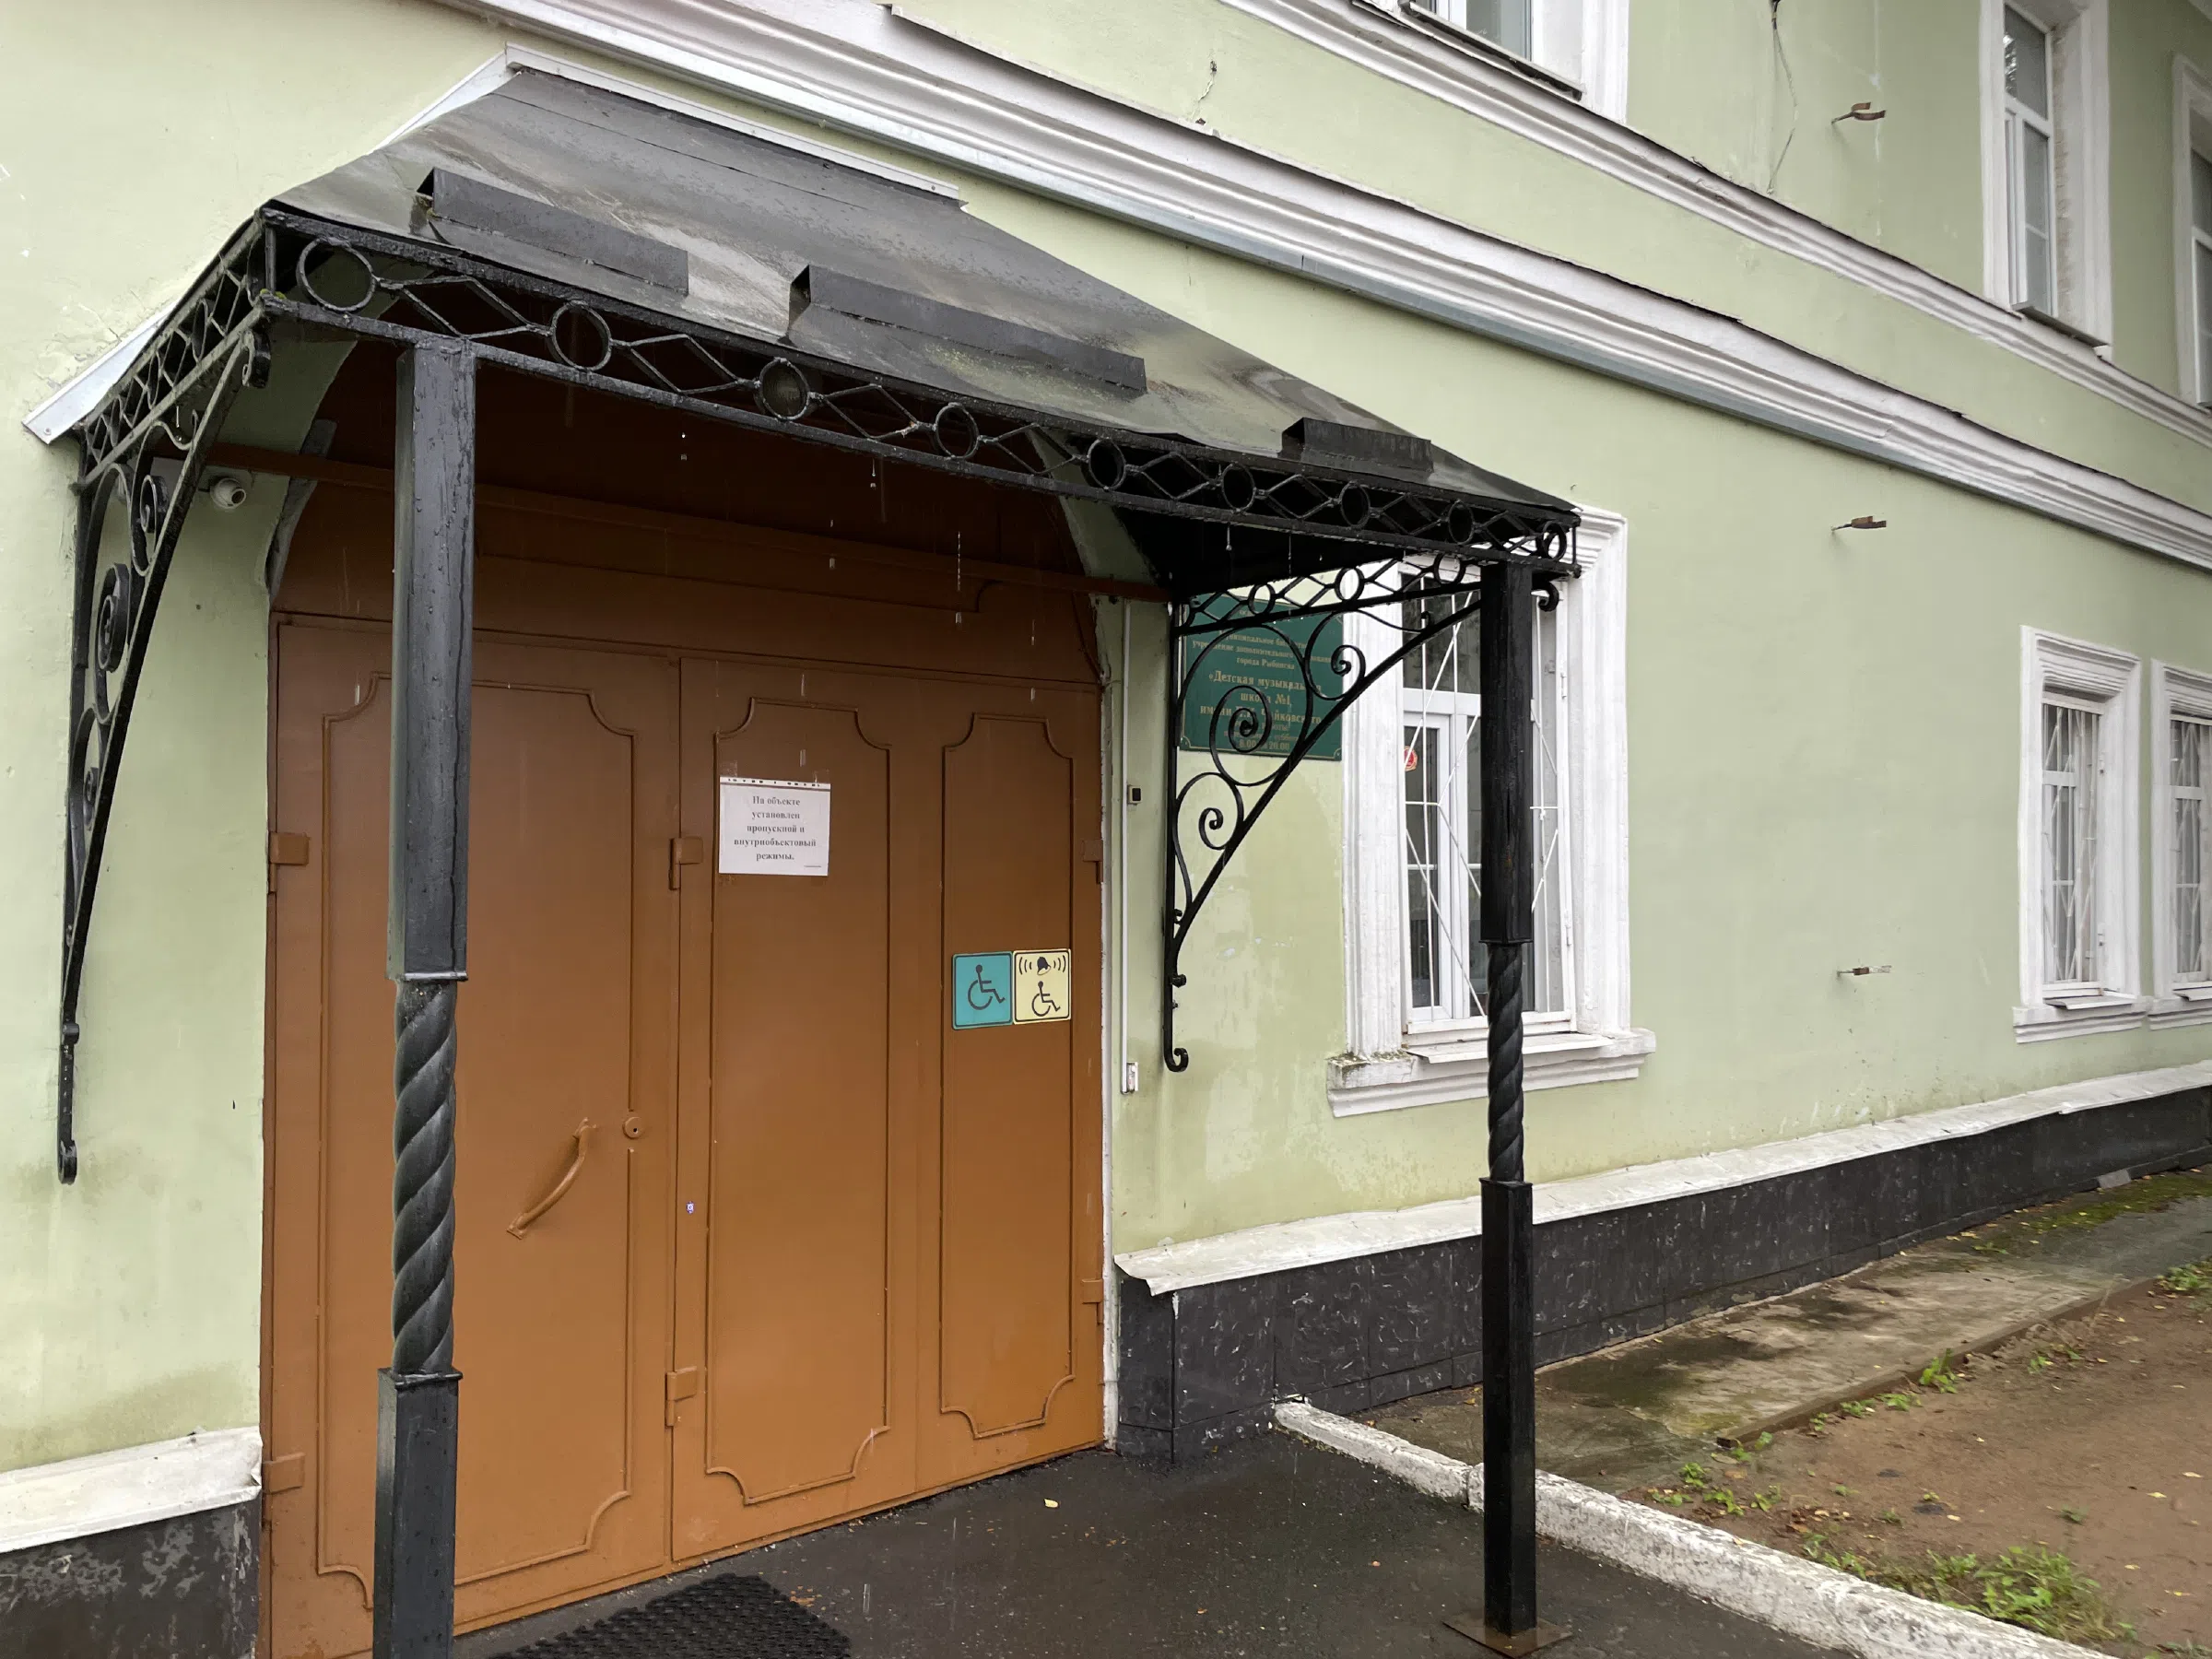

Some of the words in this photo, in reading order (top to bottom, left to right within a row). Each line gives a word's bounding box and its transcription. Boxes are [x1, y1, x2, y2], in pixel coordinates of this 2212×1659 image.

[1241, 693, 1271, 703] шкоа
[1200, 706, 1231, 716] имни
[752, 795, 765, 805] На
[767, 796, 801, 806] объекте
[751, 811, 800, 820] установлен
[747, 825, 797, 834] пропускной
[734, 838, 817, 847] внутриобъектовый
